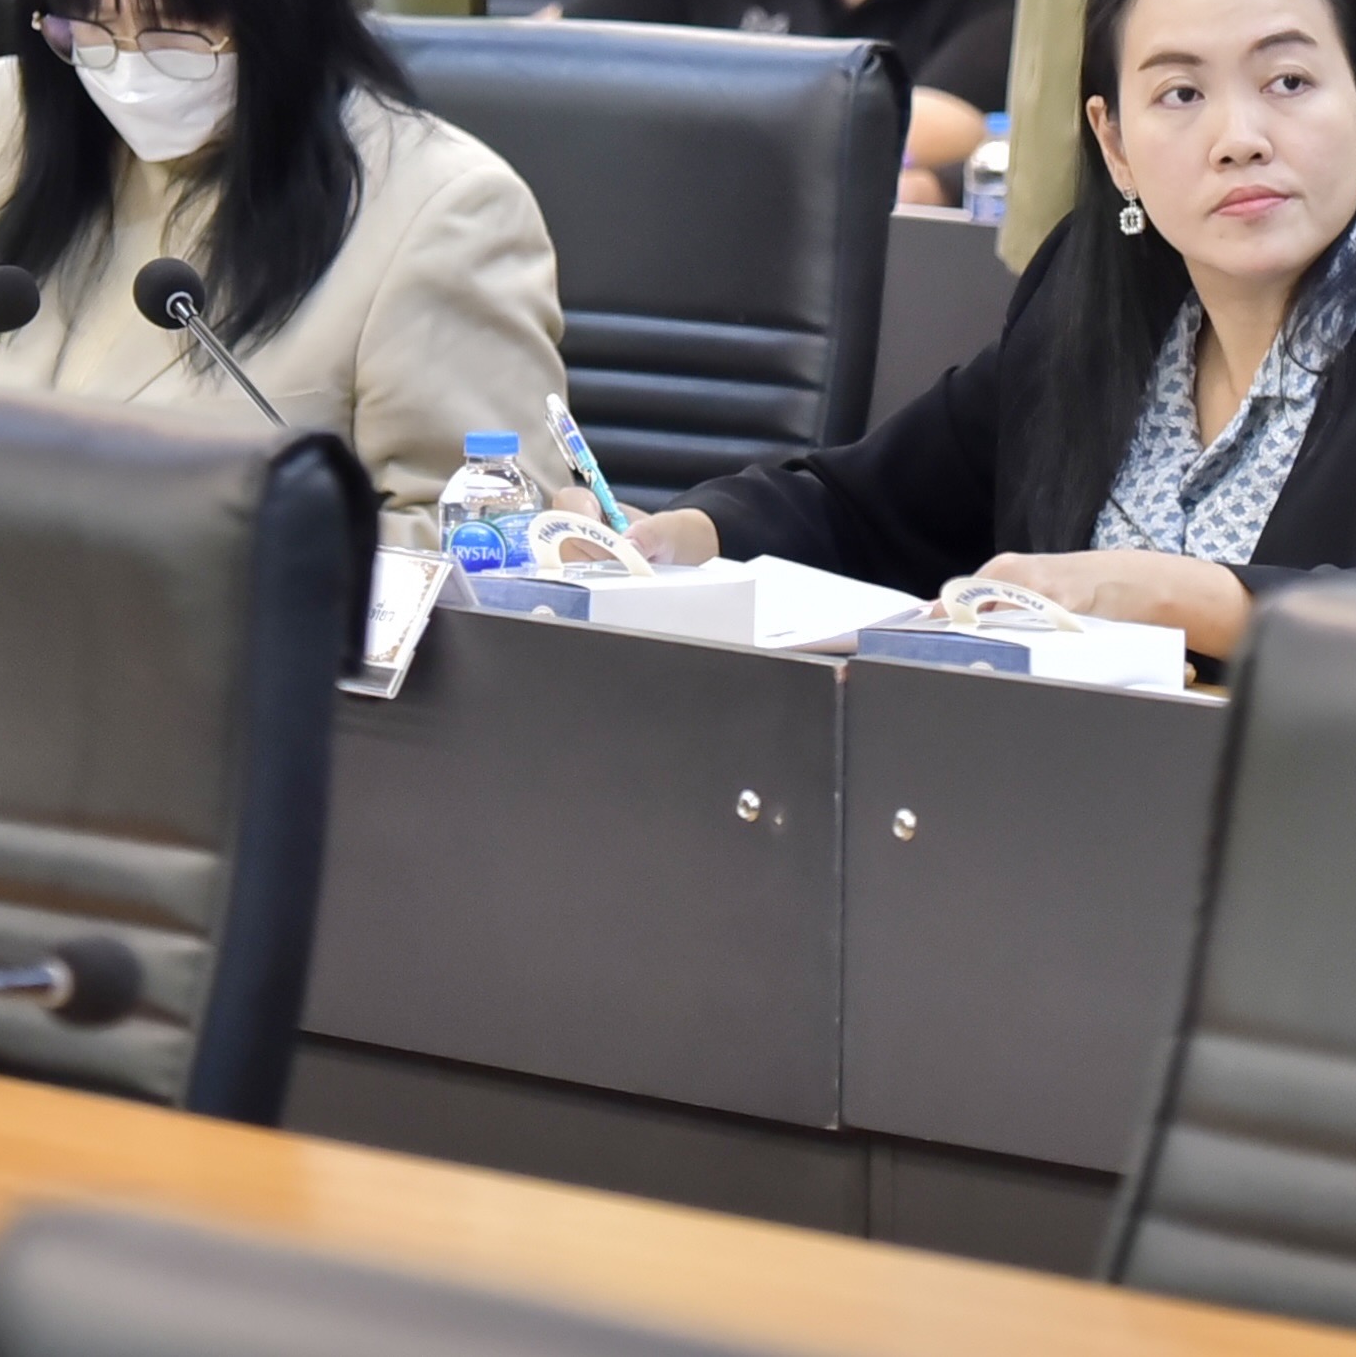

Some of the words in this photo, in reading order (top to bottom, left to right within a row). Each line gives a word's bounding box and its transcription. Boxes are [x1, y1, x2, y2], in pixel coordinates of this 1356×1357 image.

[538, 522, 575, 544] THANK
[577, 525, 614, 548] YOU
[451, 545, 502, 561] CRYSTAL
[955, 587, 1000, 606] THANK
[1002, 589, 1044, 611] YOU
